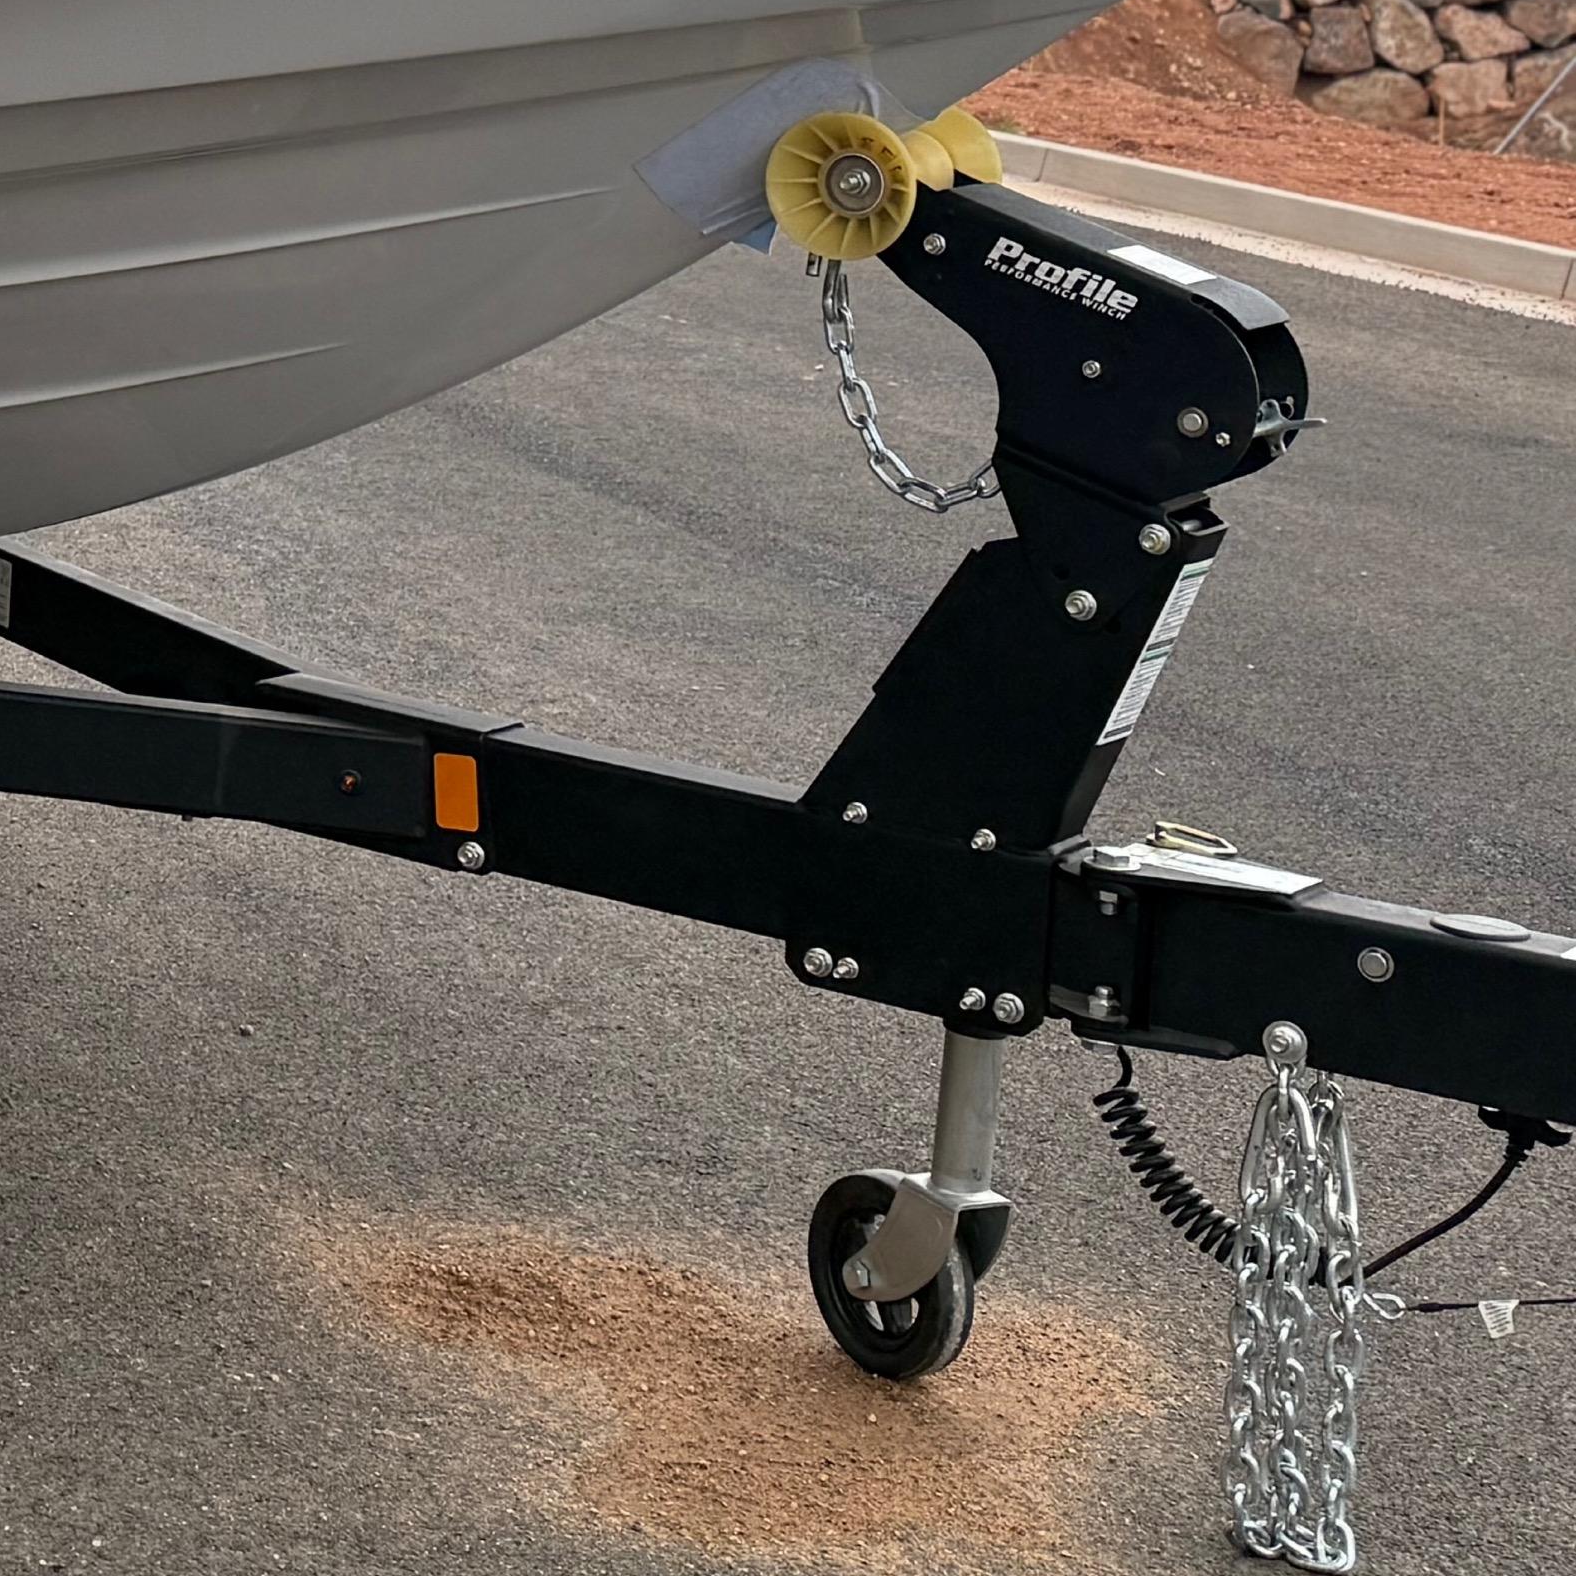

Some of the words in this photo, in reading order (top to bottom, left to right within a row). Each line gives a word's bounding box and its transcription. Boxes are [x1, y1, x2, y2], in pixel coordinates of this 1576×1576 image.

[984, 258, 1078, 301] PERFORMANCE
[1081, 296, 1127, 321] WINCH
[987, 236, 1139, 314] Profile
